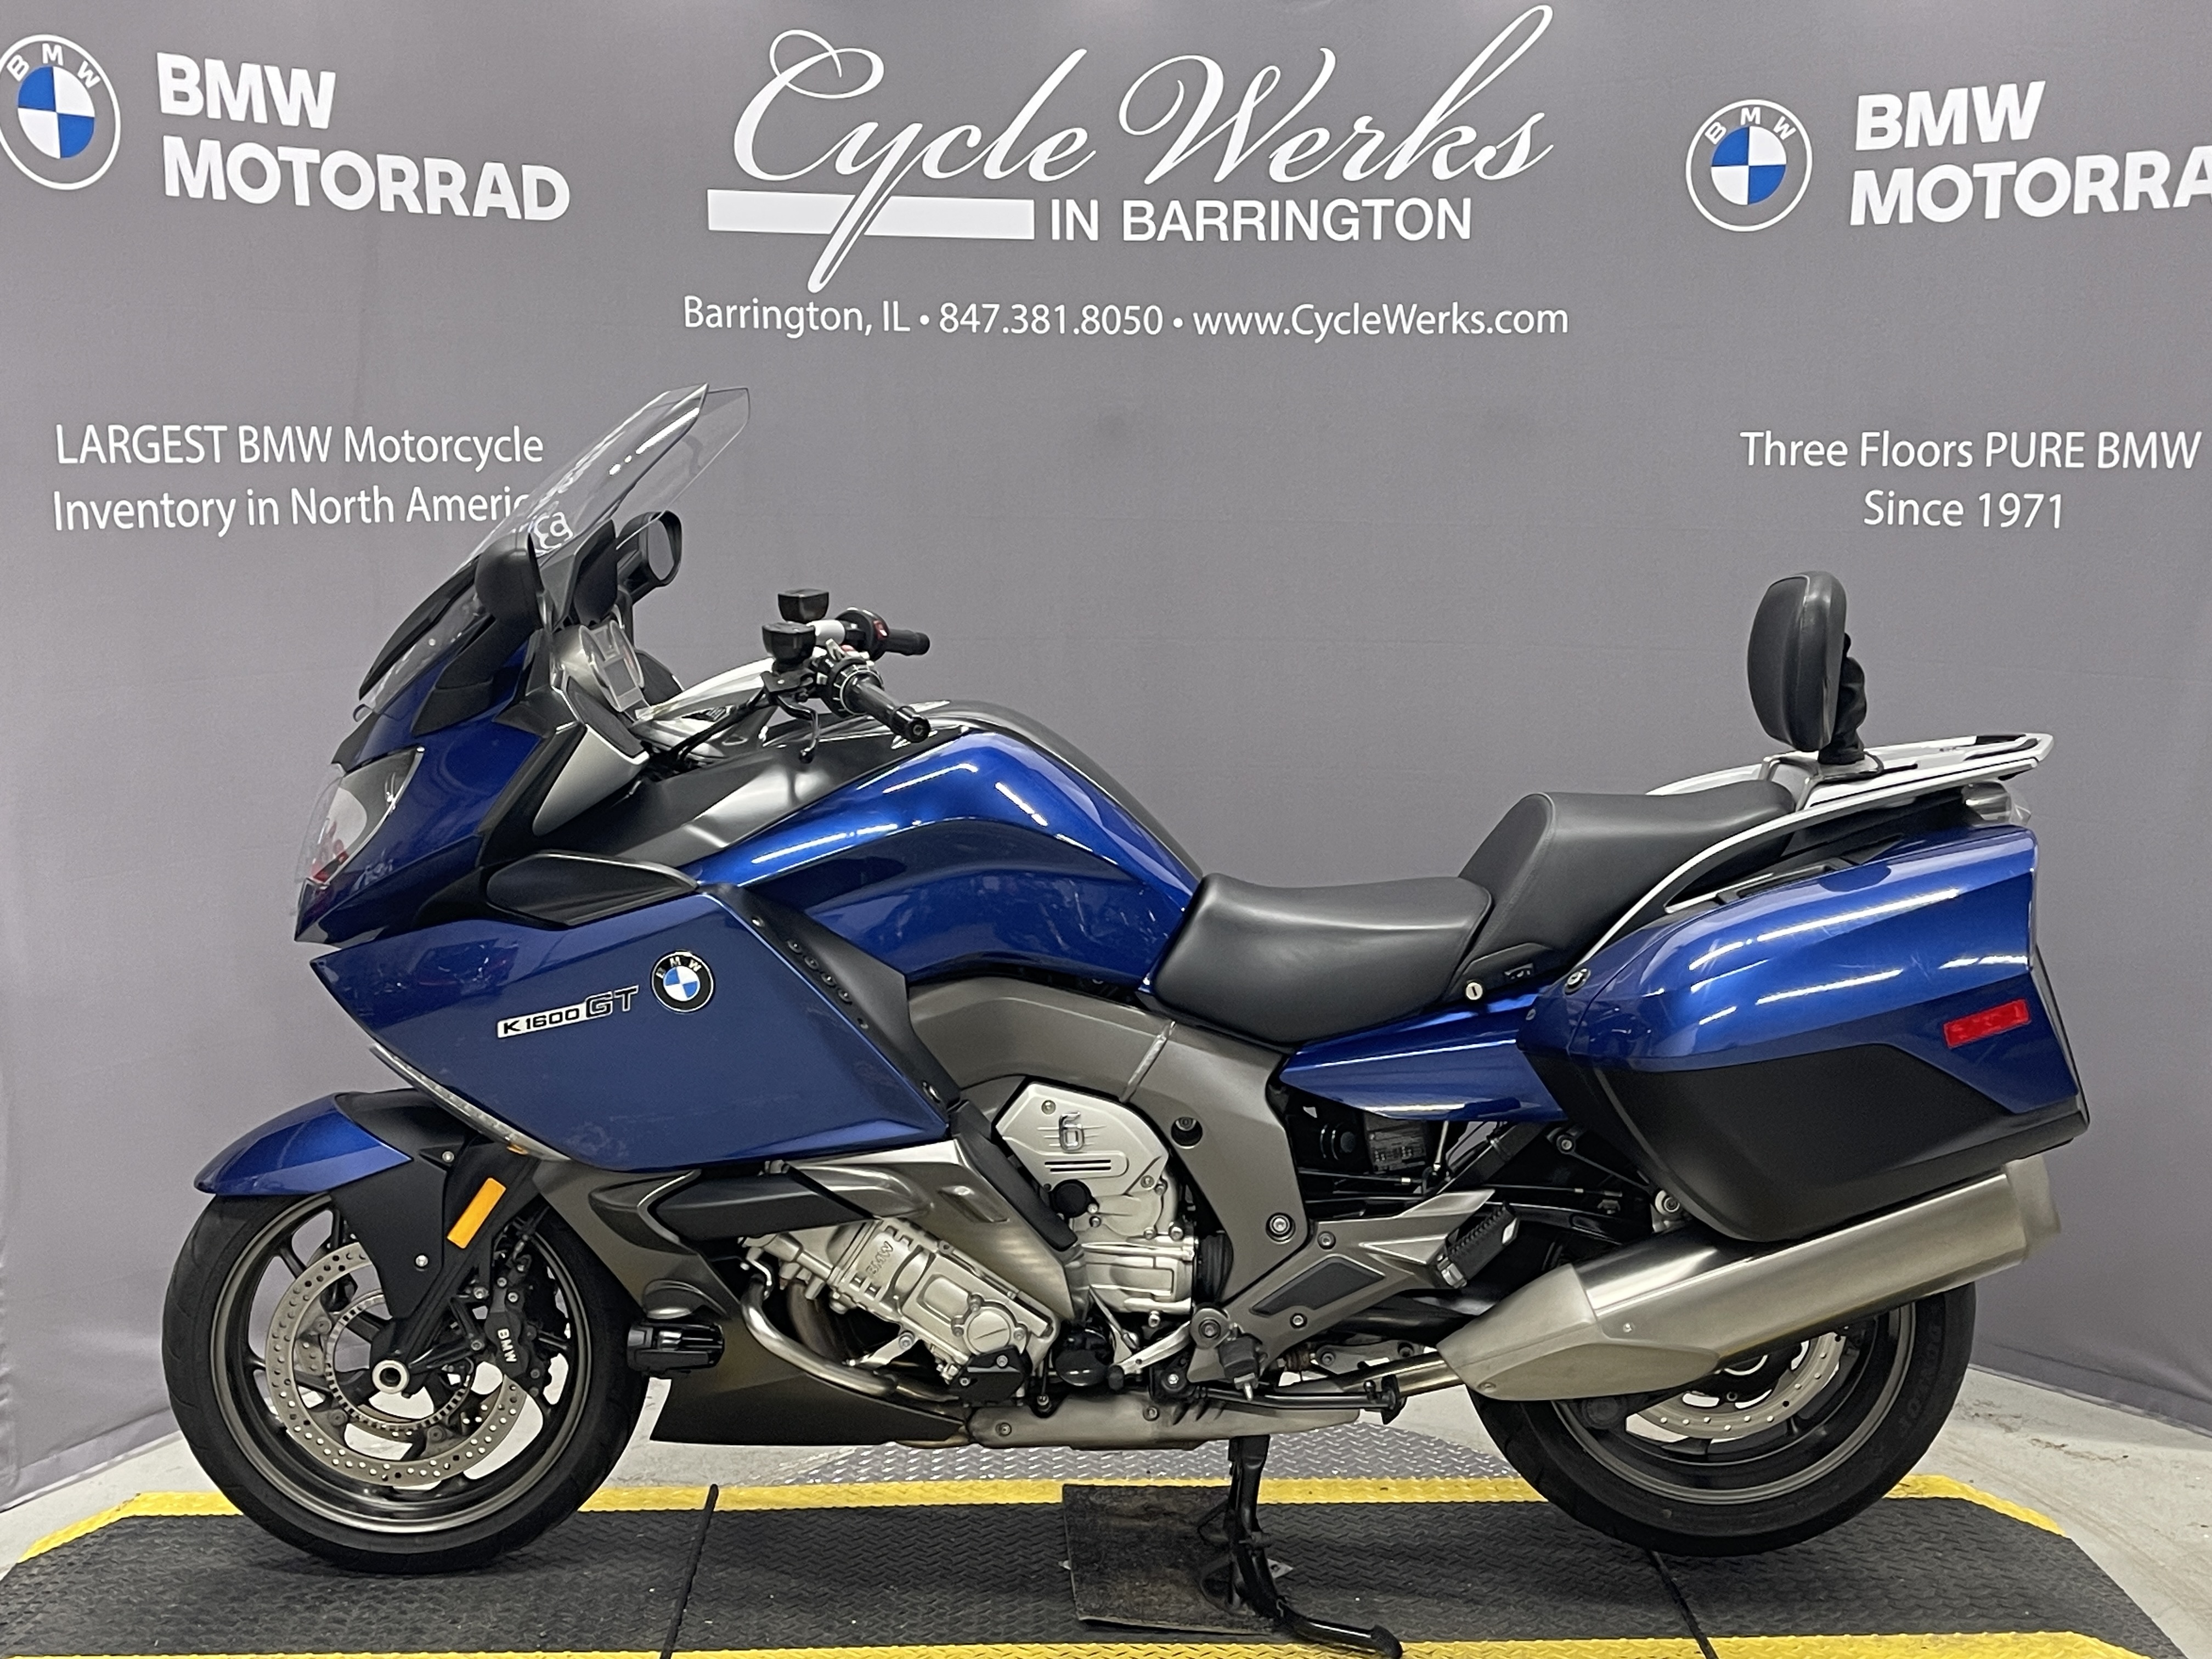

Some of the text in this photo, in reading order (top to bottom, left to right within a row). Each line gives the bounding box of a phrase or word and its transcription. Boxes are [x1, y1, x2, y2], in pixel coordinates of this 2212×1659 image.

[6, 42, 101, 89] BMW
[156, 52, 336, 129] BMW
[1704, 106, 1797, 145] BMW
[1855, 80, 2046, 151] BMW
[733, 4, 1555, 294] Cycle Werks
[162, 134, 571, 221] MOTORRAD
[1051, 197, 1471, 242] IN BARRINGTON
[684, 295, 1568, 344] Barrington, IL 847.381.8050 www.CycleWerks.com
[55, 424, 544, 473] LARGEST BMW Motorcycle
[1739, 430, 2203, 469] Three Floors PURE BMW
[53, 490, 237, 538] Inventory
[246, 488, 280, 526] in
[291, 487, 395, 525] North
[1863, 489, 2062, 529] Since 1971
[655, 956, 702, 979] BMW
[498, 1328, 517, 1362] BMW
